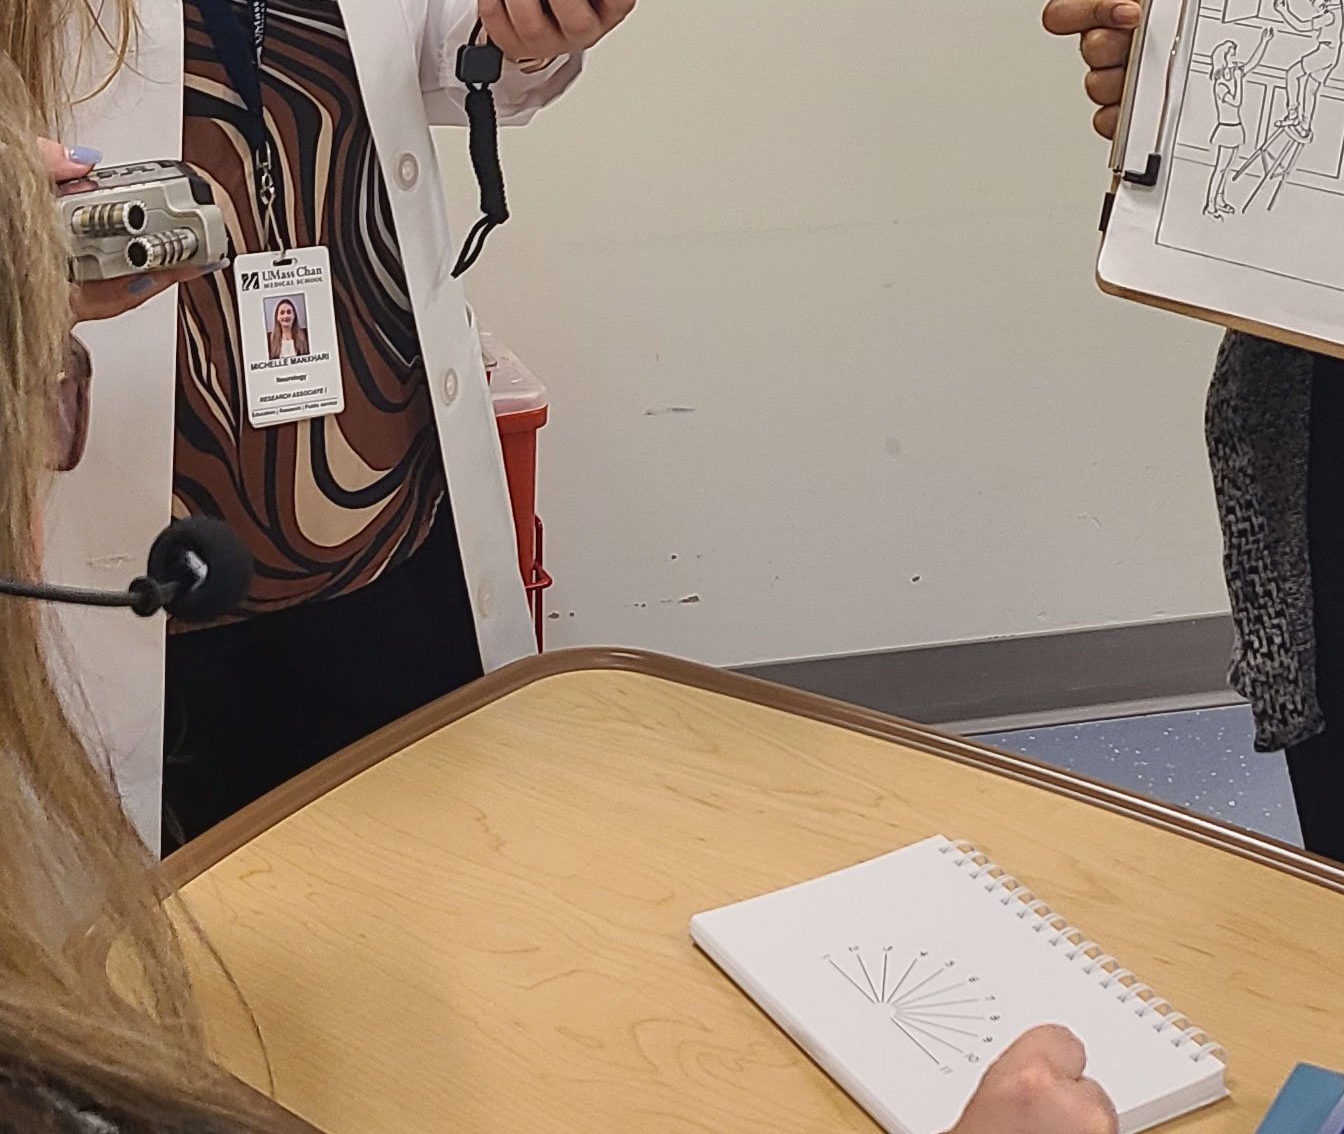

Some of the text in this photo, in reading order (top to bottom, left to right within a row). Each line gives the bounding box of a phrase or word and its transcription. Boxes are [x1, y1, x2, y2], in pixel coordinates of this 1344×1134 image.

[262, 266, 322, 282] UMass Chan
[264, 277, 323, 289] MEDICAL SCHOOL
[250, 357, 288, 371] MICHELLE
